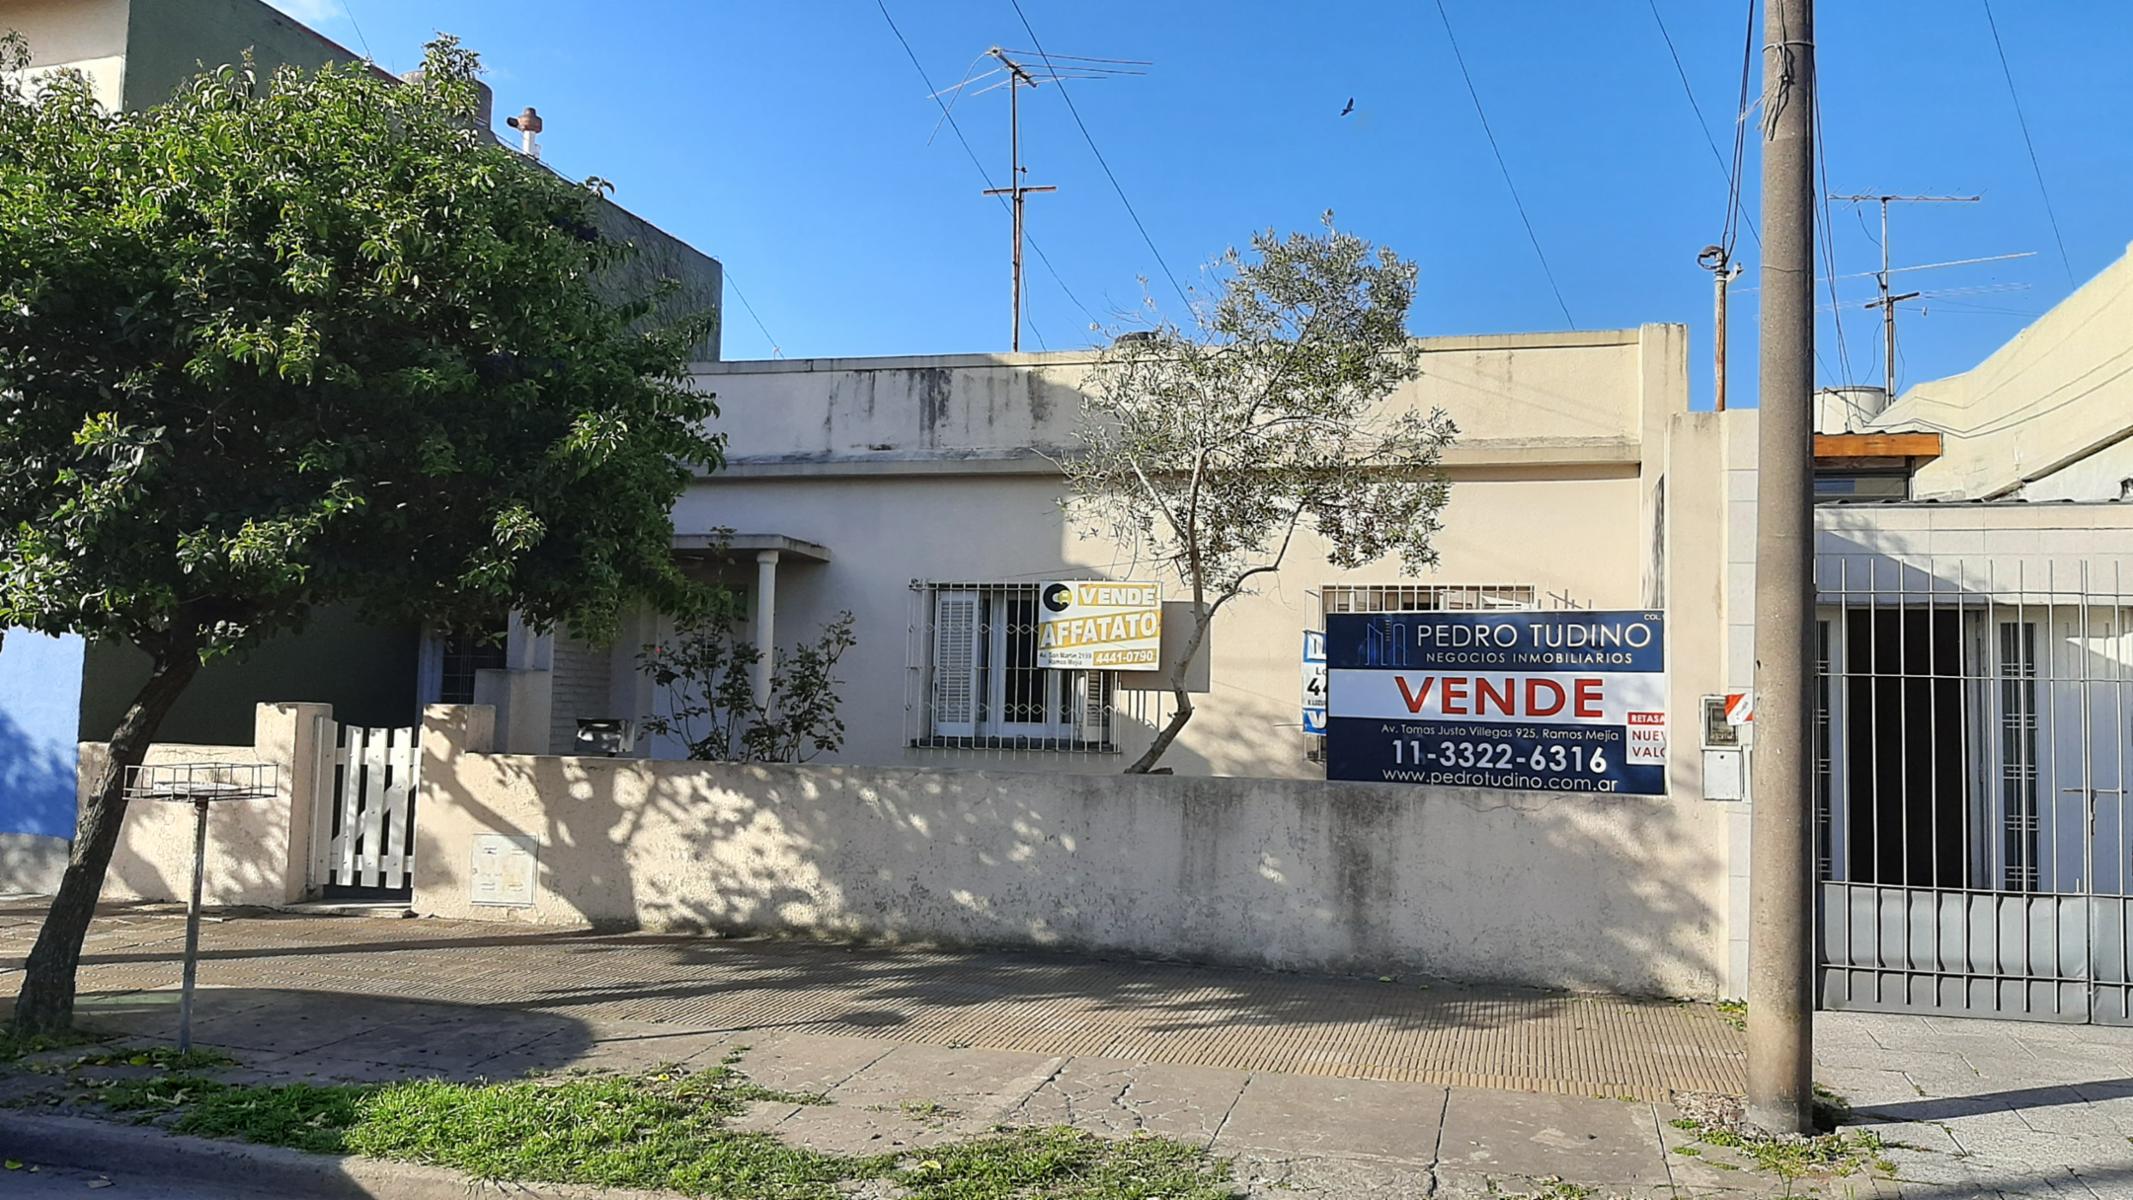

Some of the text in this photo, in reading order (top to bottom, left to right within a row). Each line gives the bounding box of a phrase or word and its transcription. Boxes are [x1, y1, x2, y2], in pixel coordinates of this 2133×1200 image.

[1079, 587, 1156, 606] VENDE
[1040, 611, 1157, 648] AFFATATO
[1418, 623, 1651, 648] PEDRO TUDINO
[1096, 651, 1153, 664] 4441-0790
[1426, 652, 1633, 665] NEGOCIOS INMOBILIARIOS
[1395, 675, 1603, 718] VENDE
[1381, 724, 1398, 734] Av.
[1401, 724, 1435, 735] Tomas
[1438, 726, 1466, 736] Justo
[1469, 726, 1512, 739] Villegas
[1542, 729, 1582, 739] Ramos
[1392, 740, 1607, 773] 11-3322-6316
[1382, 769, 1619, 792] www.pedrotudino.com.ar
